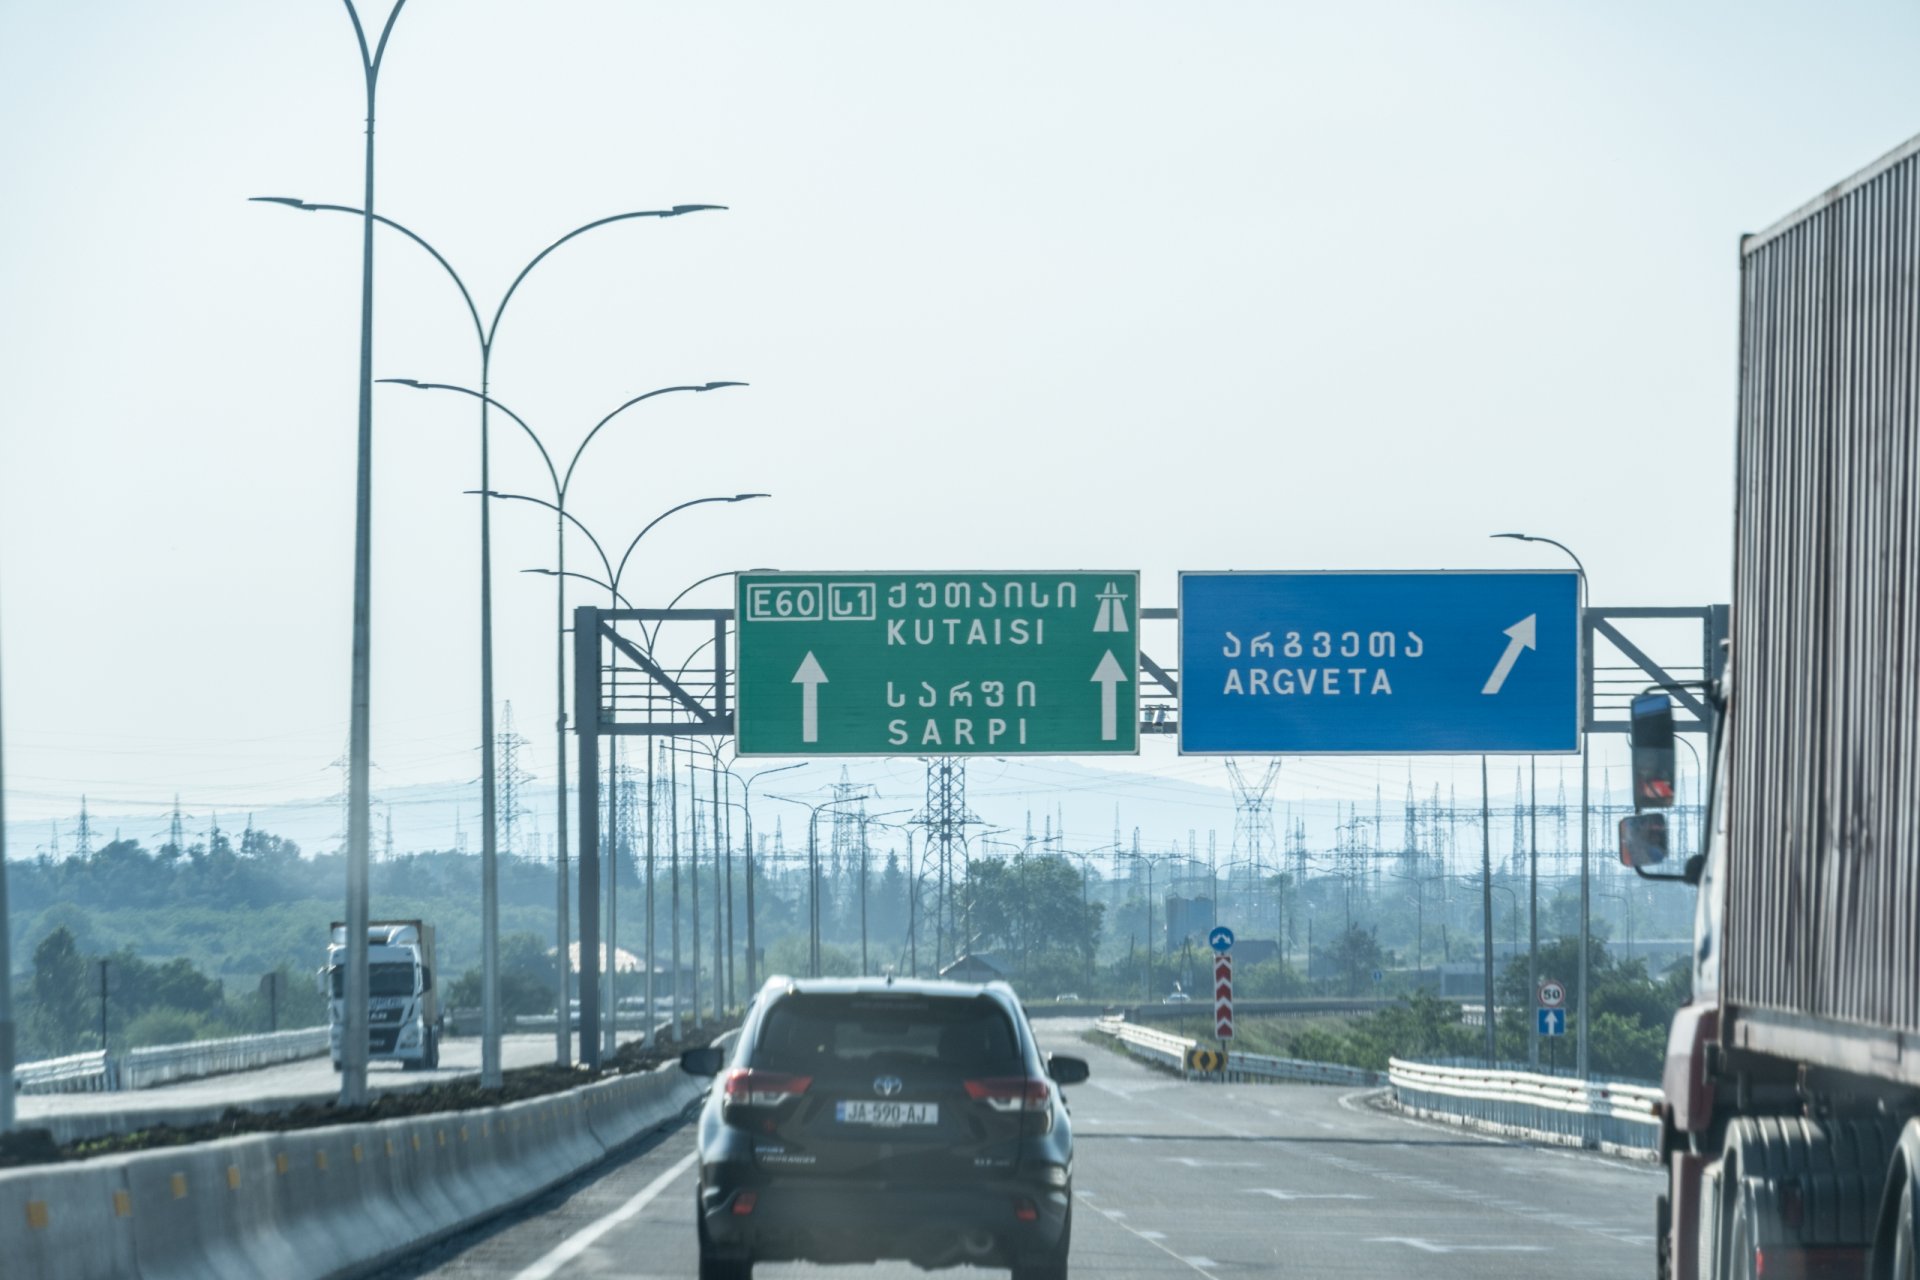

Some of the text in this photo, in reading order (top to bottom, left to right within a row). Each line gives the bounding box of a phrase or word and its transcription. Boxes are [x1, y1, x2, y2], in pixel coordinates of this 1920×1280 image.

[753, 590, 815, 616] E60
[887, 582, 1077, 608] ქუთაისი
[888, 619, 1043, 645] KUTAISI
[1223, 631, 1423, 658] არგვეთა
[887, 681, 1036, 707] სარფი
[1223, 668, 1393, 695] ARGVETA
[888, 719, 1027, 745] SARPI
[1543, 989, 1560, 1000] 50
